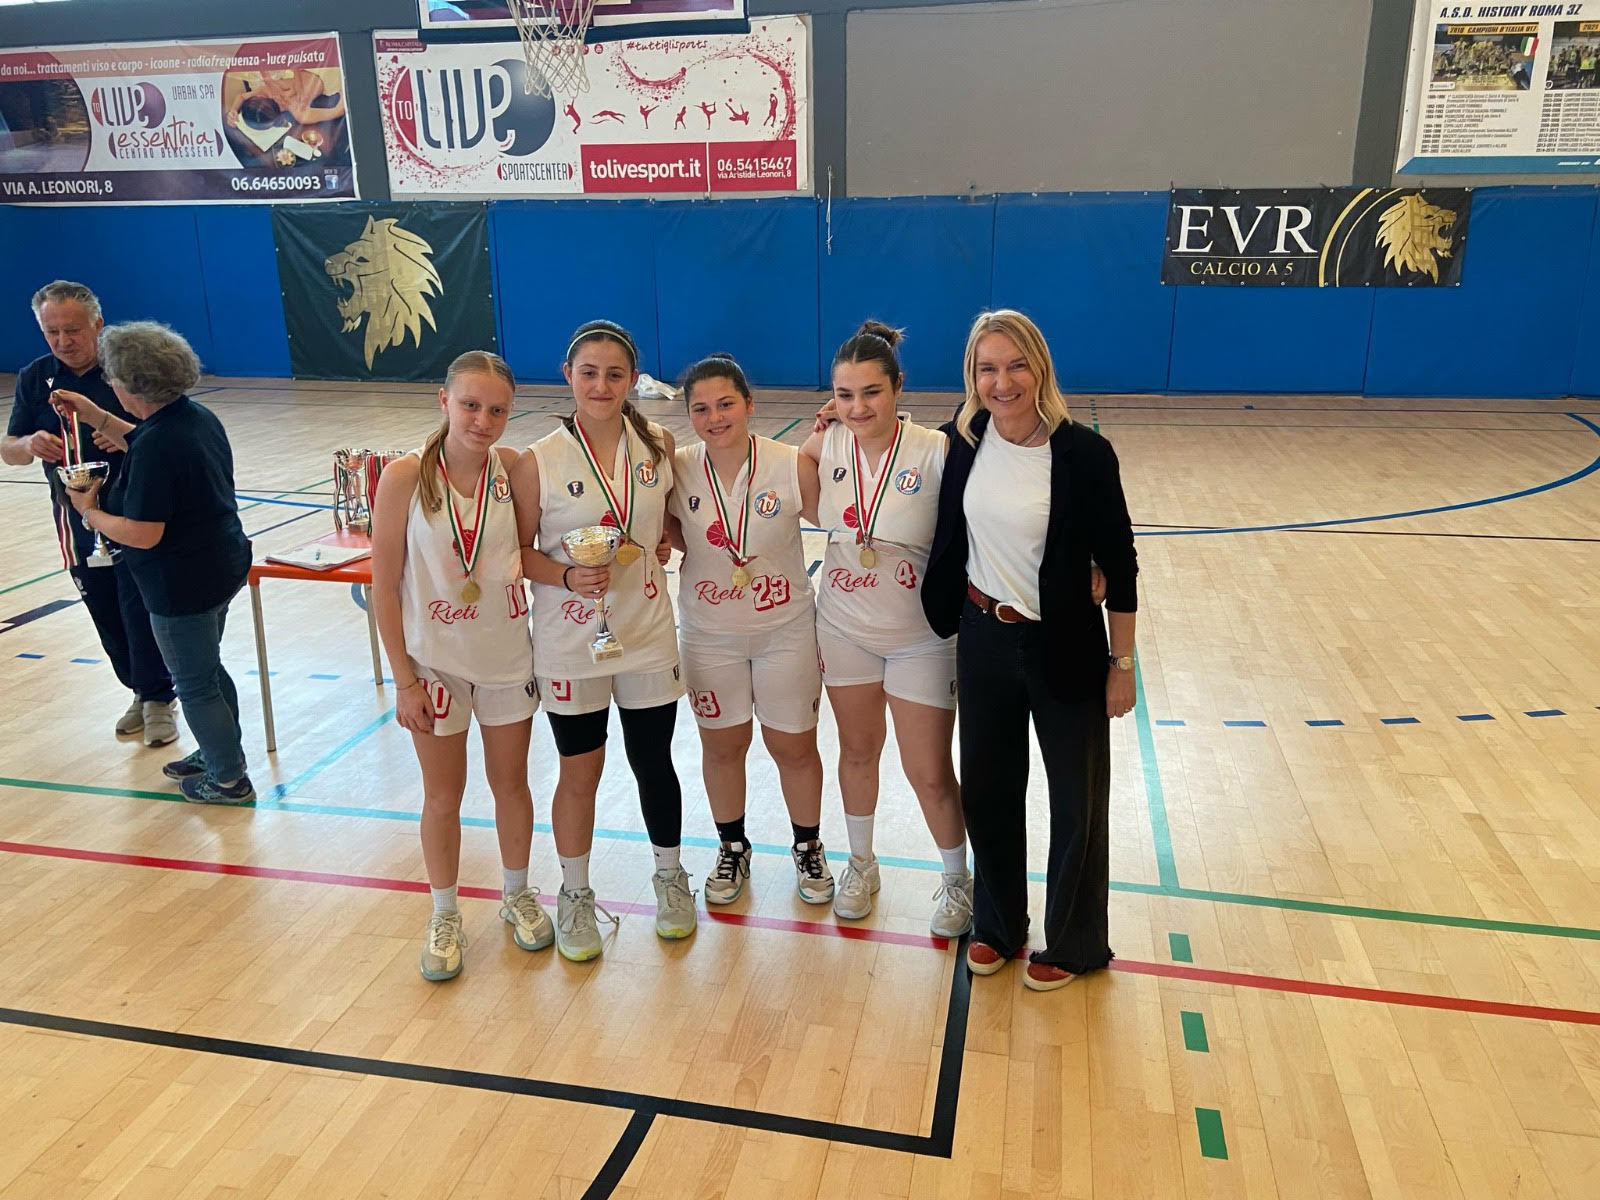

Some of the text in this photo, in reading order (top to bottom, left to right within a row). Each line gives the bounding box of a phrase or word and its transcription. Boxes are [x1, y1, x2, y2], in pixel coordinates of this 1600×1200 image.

[1440, 4, 1583, 18] A.S.D. HISTORY ROMA 3Z
[626, 40, 708, 54] #tuttiglisports
[1, 64, 11, 76] da
[37, 60, 90, 74] trattamenti
[91, 60, 109, 72] viso
[111, 63, 117, 71] e
[118, 61, 143, 73] corpo
[150, 57, 180, 69] icoone
[188, 55, 259, 69] radiofrequenza
[267, 52, 286, 65] luce
[287, 51, 325, 66] pulsata
[172, 84, 215, 100] URBAN SPA
[92, 103, 100, 112] TO
[397, 100, 413, 120] TO
[119, 147, 154, 159] CENTRO
[503, 162, 569, 181] SPORTSCENTER
[590, 158, 701, 182] tolivesport.it
[717, 157, 792, 172] 06.5415467
[231, 175, 321, 191] 06.64650093
[729, 171, 756, 179] Aristide
[757, 171, 786, 179] Leonori,
[787, 170, 793, 178] 8
[2, 179, 113, 195] VIA A. LEONORI, 8
[1171, 205, 1318, 254] EVR
[1191, 261, 1293, 276] CALCIO A 5
[828, 568, 879, 592] Rieti
[895, 560, 917, 589] 4
[694, 580, 746, 605] Rieti
[751, 574, 790, 612] 23
[428, 600, 479, 624] Rieti
[561, 600, 613, 624] Riei
